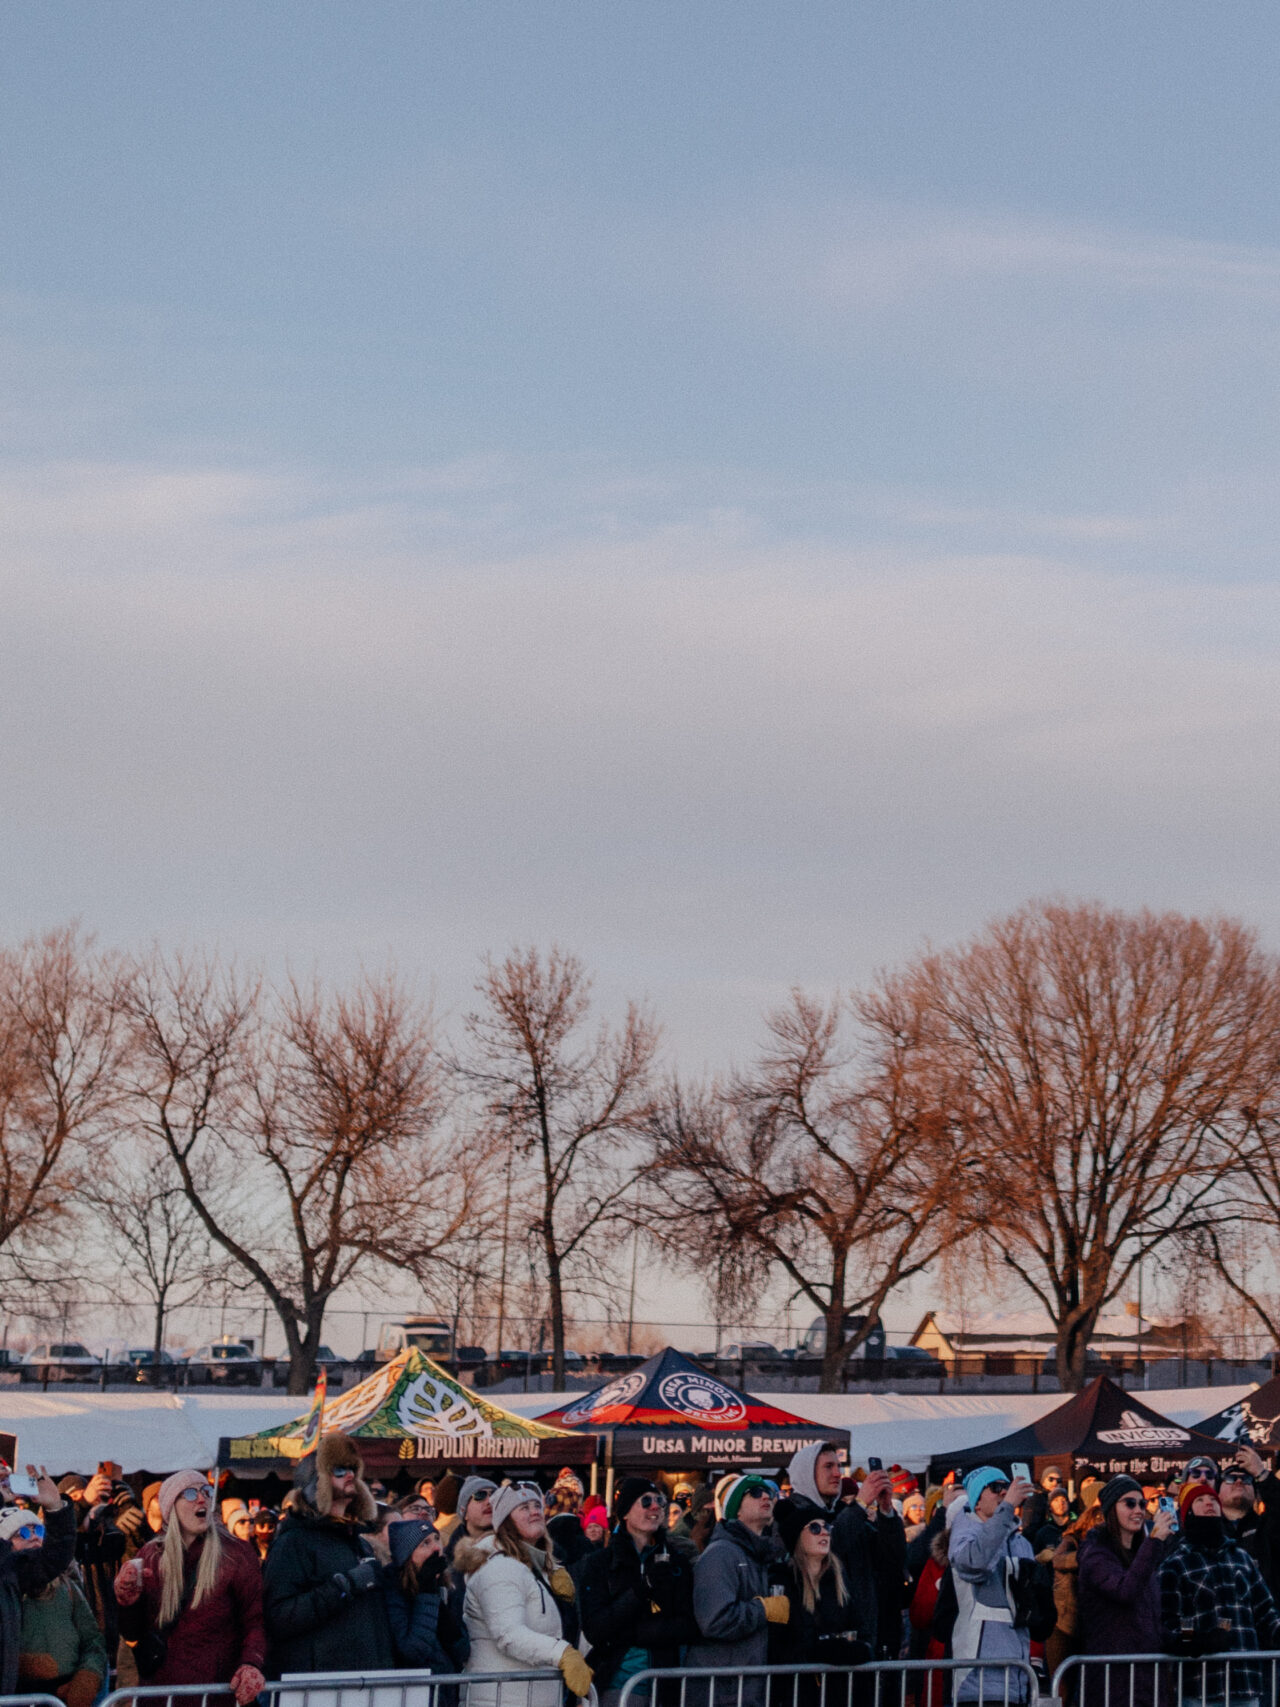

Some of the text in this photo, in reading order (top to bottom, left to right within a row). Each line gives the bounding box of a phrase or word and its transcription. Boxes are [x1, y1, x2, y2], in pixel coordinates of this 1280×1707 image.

[665, 1378, 685, 1398] URSA
[686, 1376, 732, 1399] MINOR
[682, 1407, 740, 1421] BREWING
[691, 1435, 746, 1453] MINOR
[751, 1435, 822, 1452] BREWIN
[1105, 1429, 1182, 1441] INVICTUS
[477, 1436, 540, 1459] BREWING
[1109, 1458, 1128, 1473] for
[1130, 1457, 1148, 1475] the
